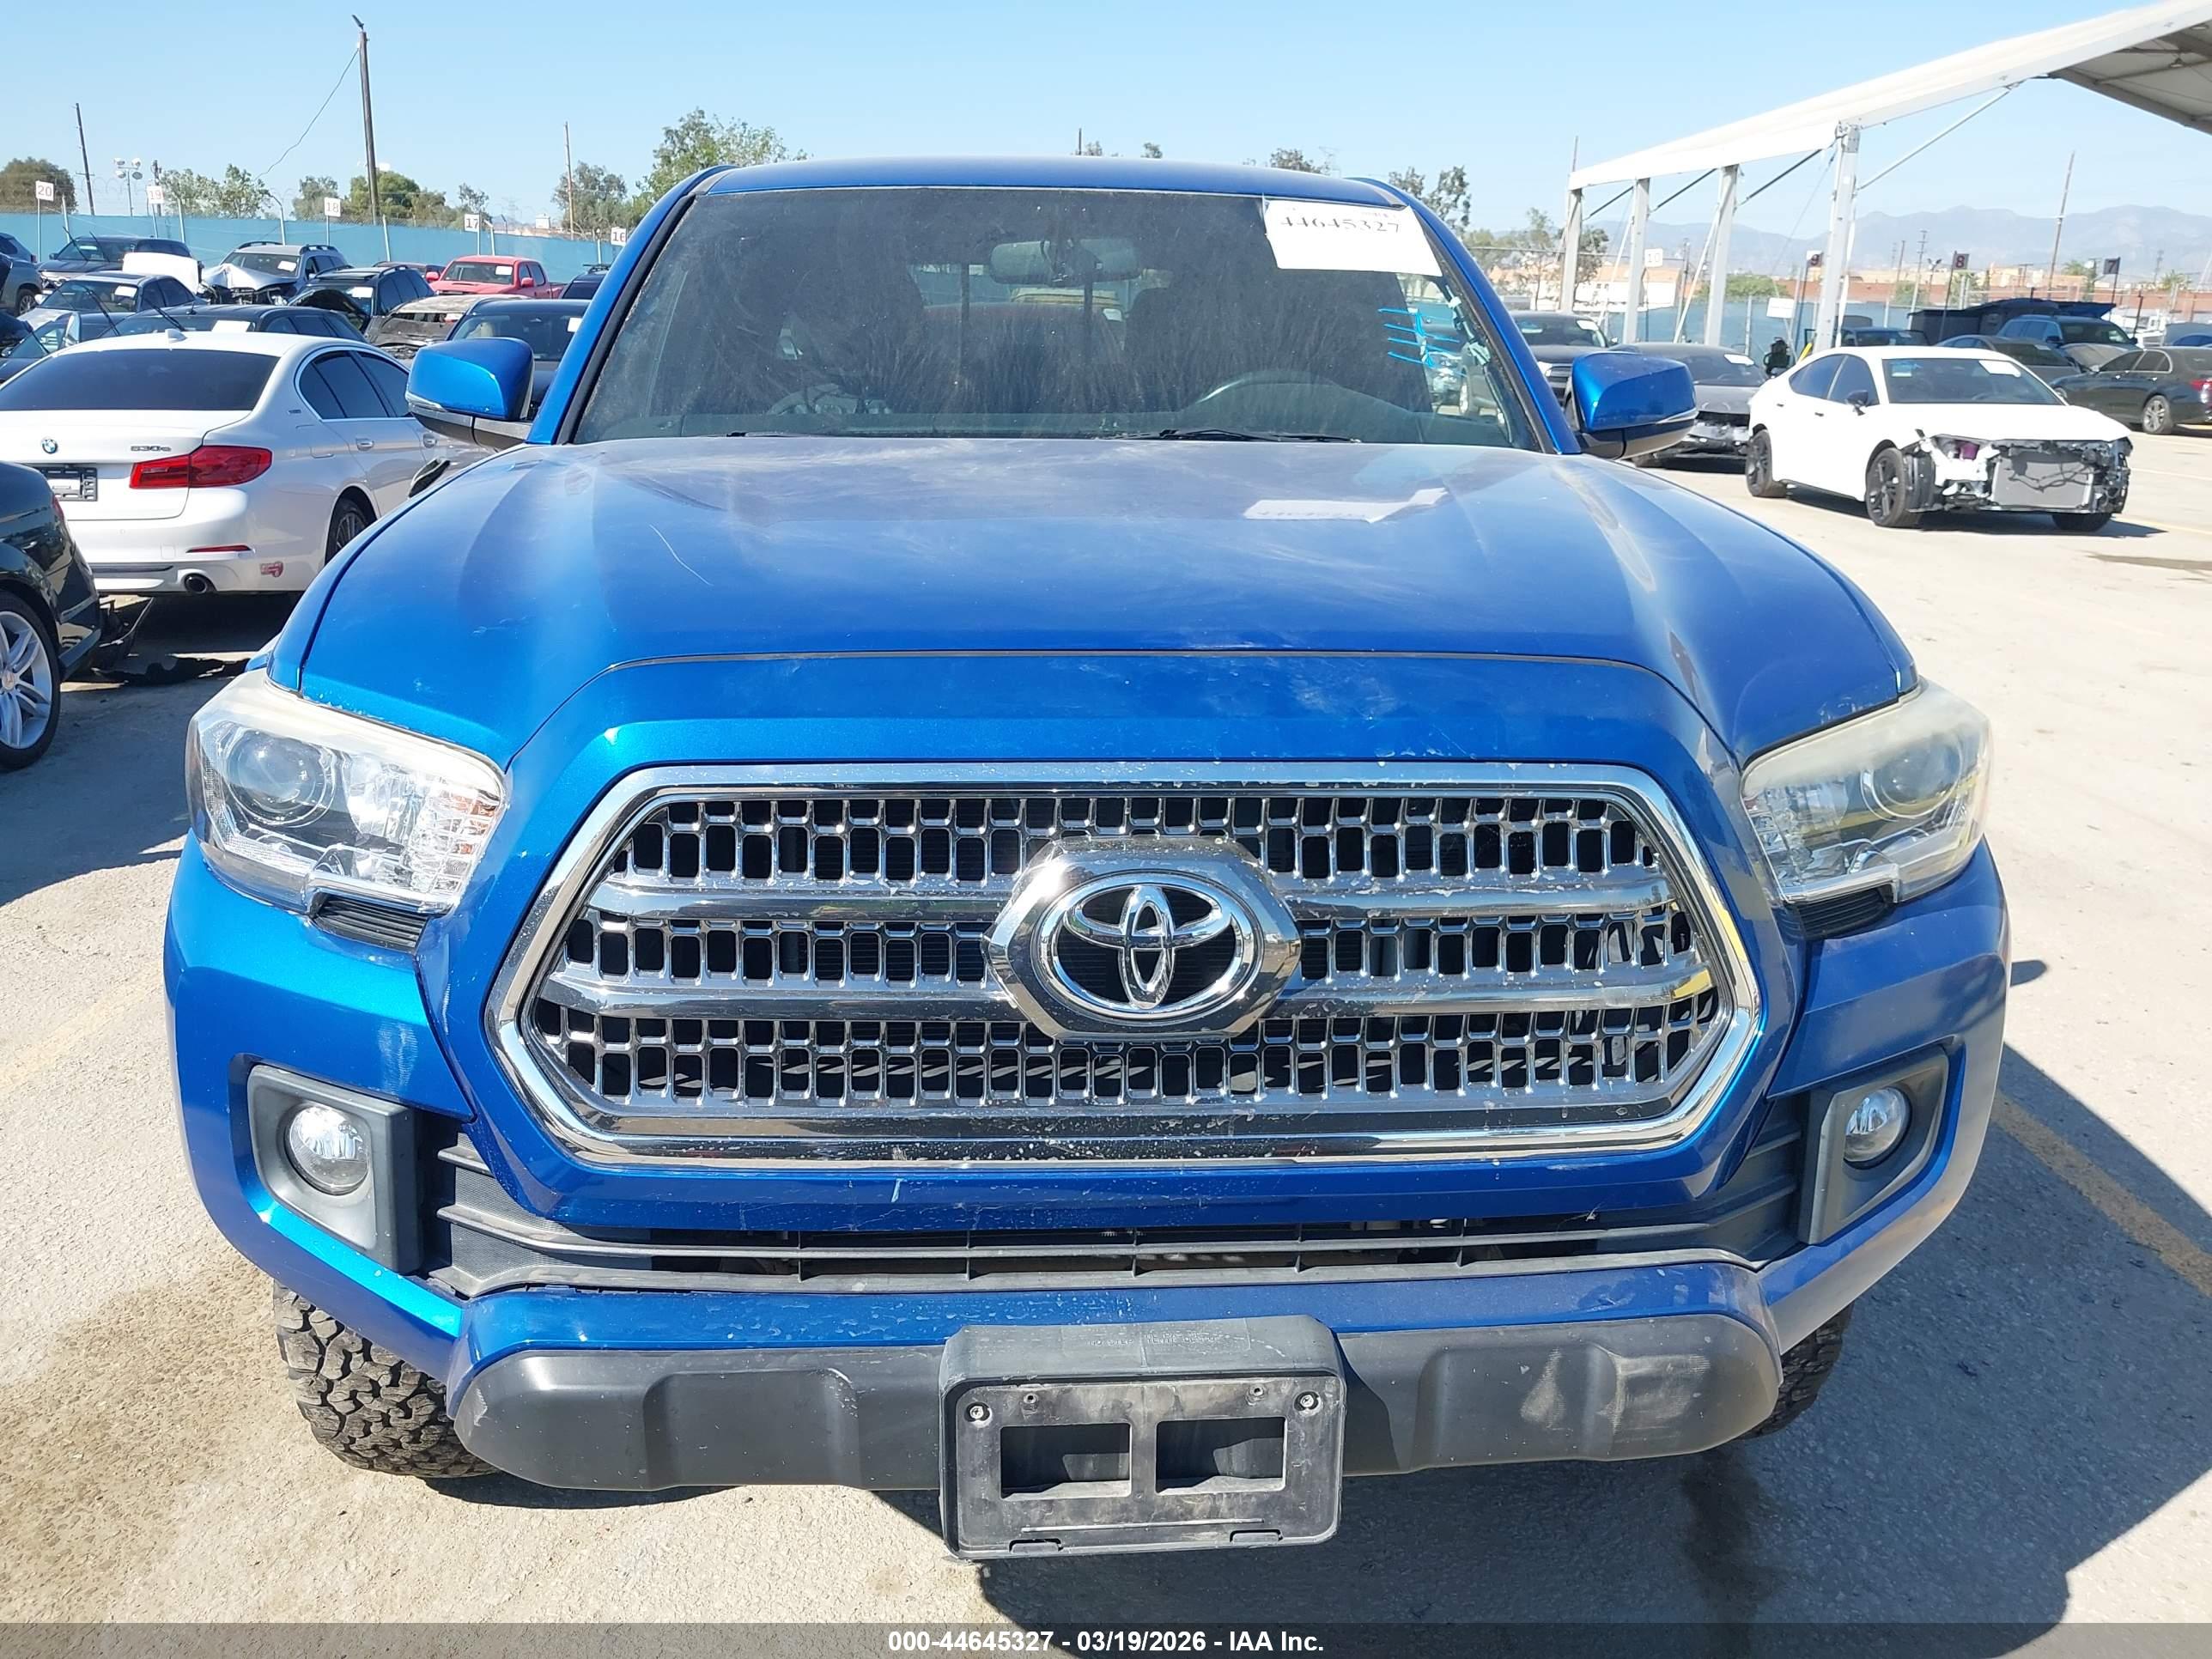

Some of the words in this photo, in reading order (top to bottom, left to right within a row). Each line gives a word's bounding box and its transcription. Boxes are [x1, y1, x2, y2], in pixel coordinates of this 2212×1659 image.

[38, 185, 52, 197] 20
[149, 190, 161, 200] 19
[326, 202, 339, 213] 18
[465, 217, 479, 229] 17
[1280, 216, 1401, 233] 44645327
[1647, 253, 1661, 263] 10
[1811, 253, 1820, 265] 9
[1956, 254, 1965, 268] 8
[2106, 259, 2117, 272] 7
